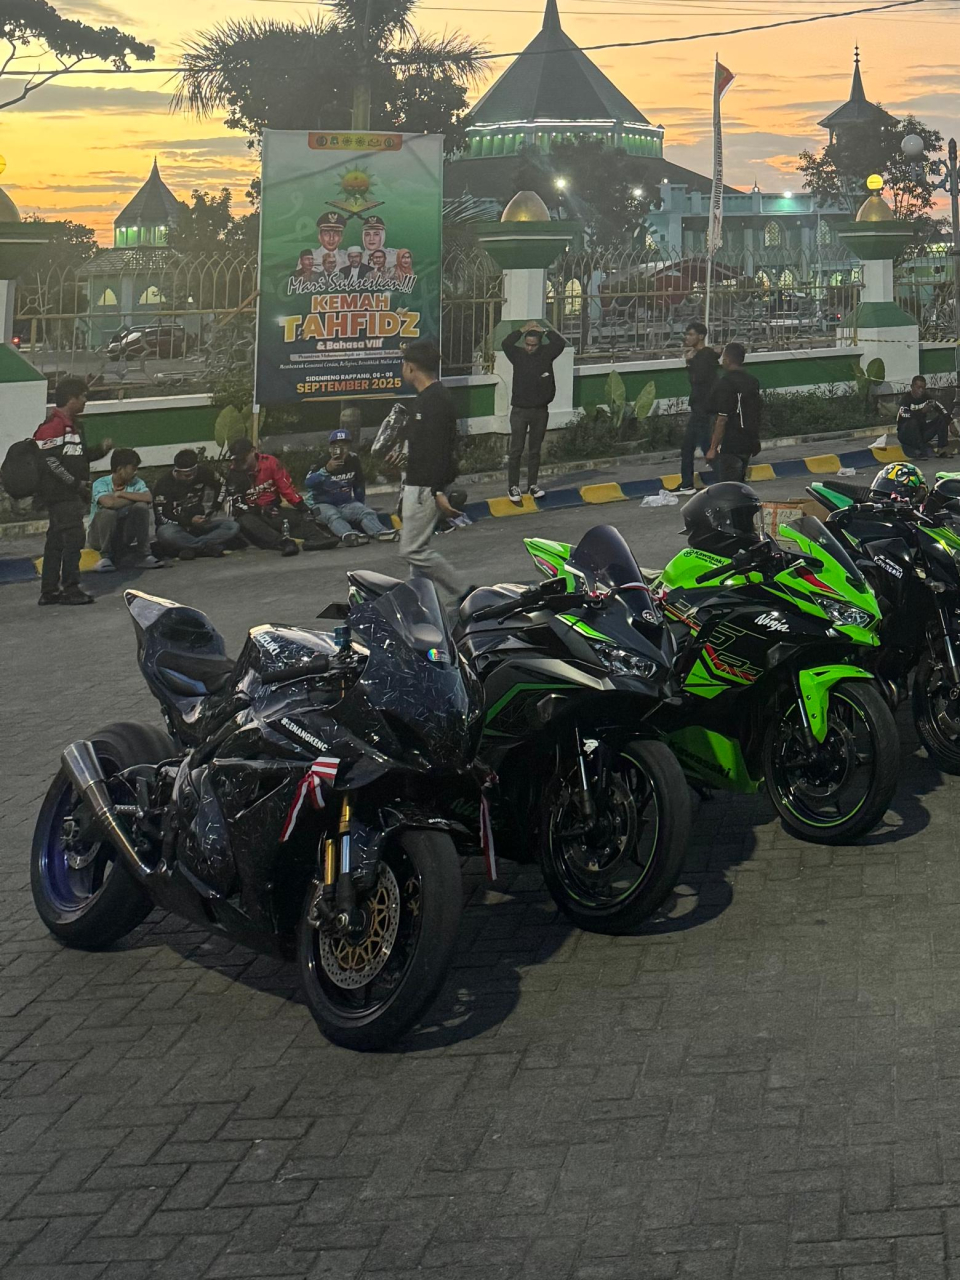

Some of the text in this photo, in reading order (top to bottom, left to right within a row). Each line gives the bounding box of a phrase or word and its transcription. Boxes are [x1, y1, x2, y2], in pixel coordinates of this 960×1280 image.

[287, 276, 325, 295] Mari
[311, 293, 391, 313] KEMAH
[279, 312, 420, 342] TAHFIDZ
[316, 341, 326, 350] &
[326, 340, 366, 350] Bahasa
[296, 377, 402, 393] SEPTEMBER 2025
[694, 550, 725, 566] Kawasaki
[754, 612, 790, 632] Ninja
[256, 632, 281, 656] UZUKI
